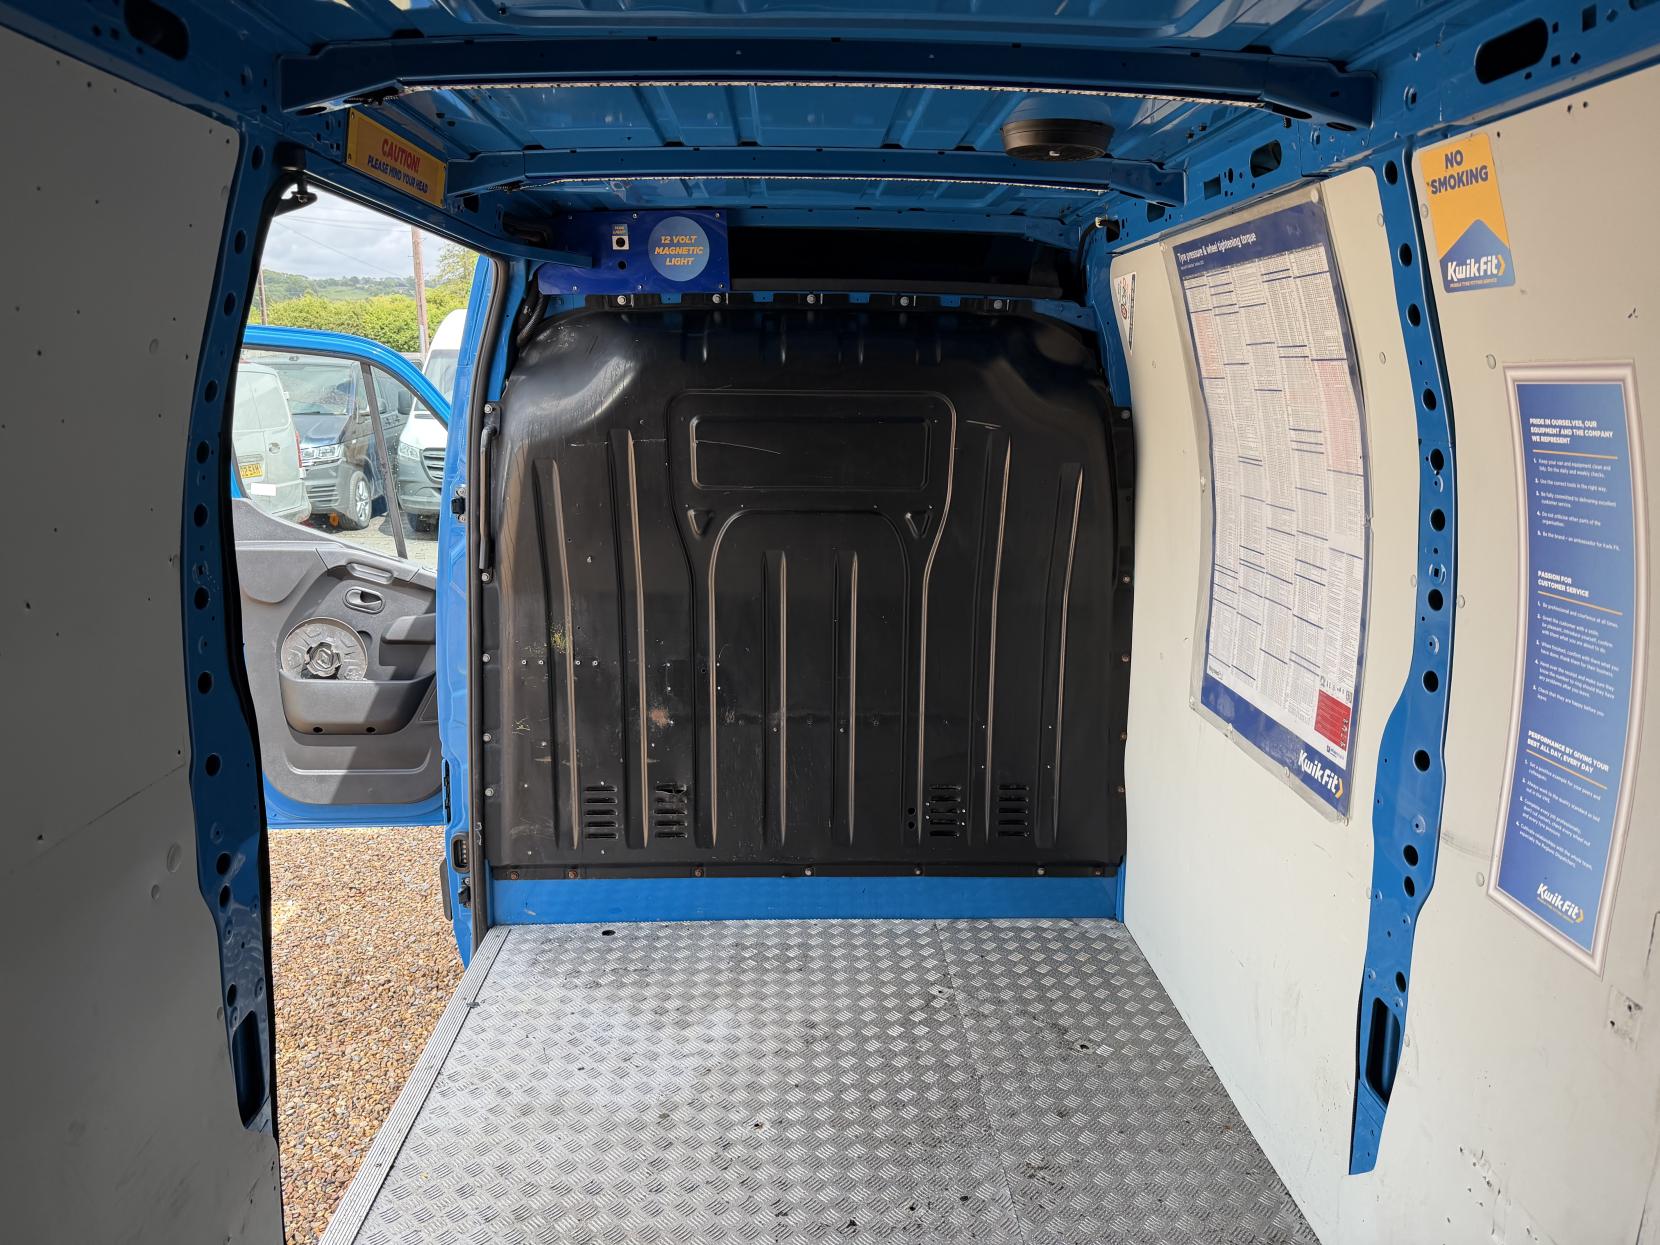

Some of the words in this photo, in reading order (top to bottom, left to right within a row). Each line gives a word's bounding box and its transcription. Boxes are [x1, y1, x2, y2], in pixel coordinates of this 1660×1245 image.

[382, 138, 421, 173] CAUTION!
[1444, 149, 1464, 169] NO
[368, 154, 388, 174] PLEASE
[389, 165, 402, 180] MIND
[402, 172, 416, 188] YOUR
[416, 180, 428, 193] HEAD
[1430, 165, 1488, 195] SMOKING
[660, 236, 670, 244] 12
[672, 235, 697, 244] VOLT
[1177, 252, 1187, 264] Tyre
[1187, 248, 1203, 262] pressure
[1207, 242, 1218, 253] wheel
[1218, 237, 1242, 252] tightening
[1241, 233, 1256, 244] torque
[654, 246, 704, 256] MAGNETIC
[666, 257, 694, 266] LIGHT
[1552, 419, 1584, 427] OURSELVES,
[1585, 430, 1613, 438] COMPANY
[1538, 571, 1560, 582] PASSION
[1561, 576, 1572, 584] FOR
[1538, 579, 1565, 592] CUSTOMER
[1566, 586, 1589, 598] SERVICE
[1528, 730, 1565, 752] PERFORMANCE
[1566, 747, 1574, 756] BY
[1574, 750, 1593, 765] GIVING
[1593, 759, 1609, 772] YOUR
[1528, 738, 1540, 749] BEST
[1540, 744, 1550, 754] ALL
[1550, 748, 1563, 760] DAY,
[1563, 754, 1582, 769] EVERY
[1581, 762, 1594, 775] DAY
